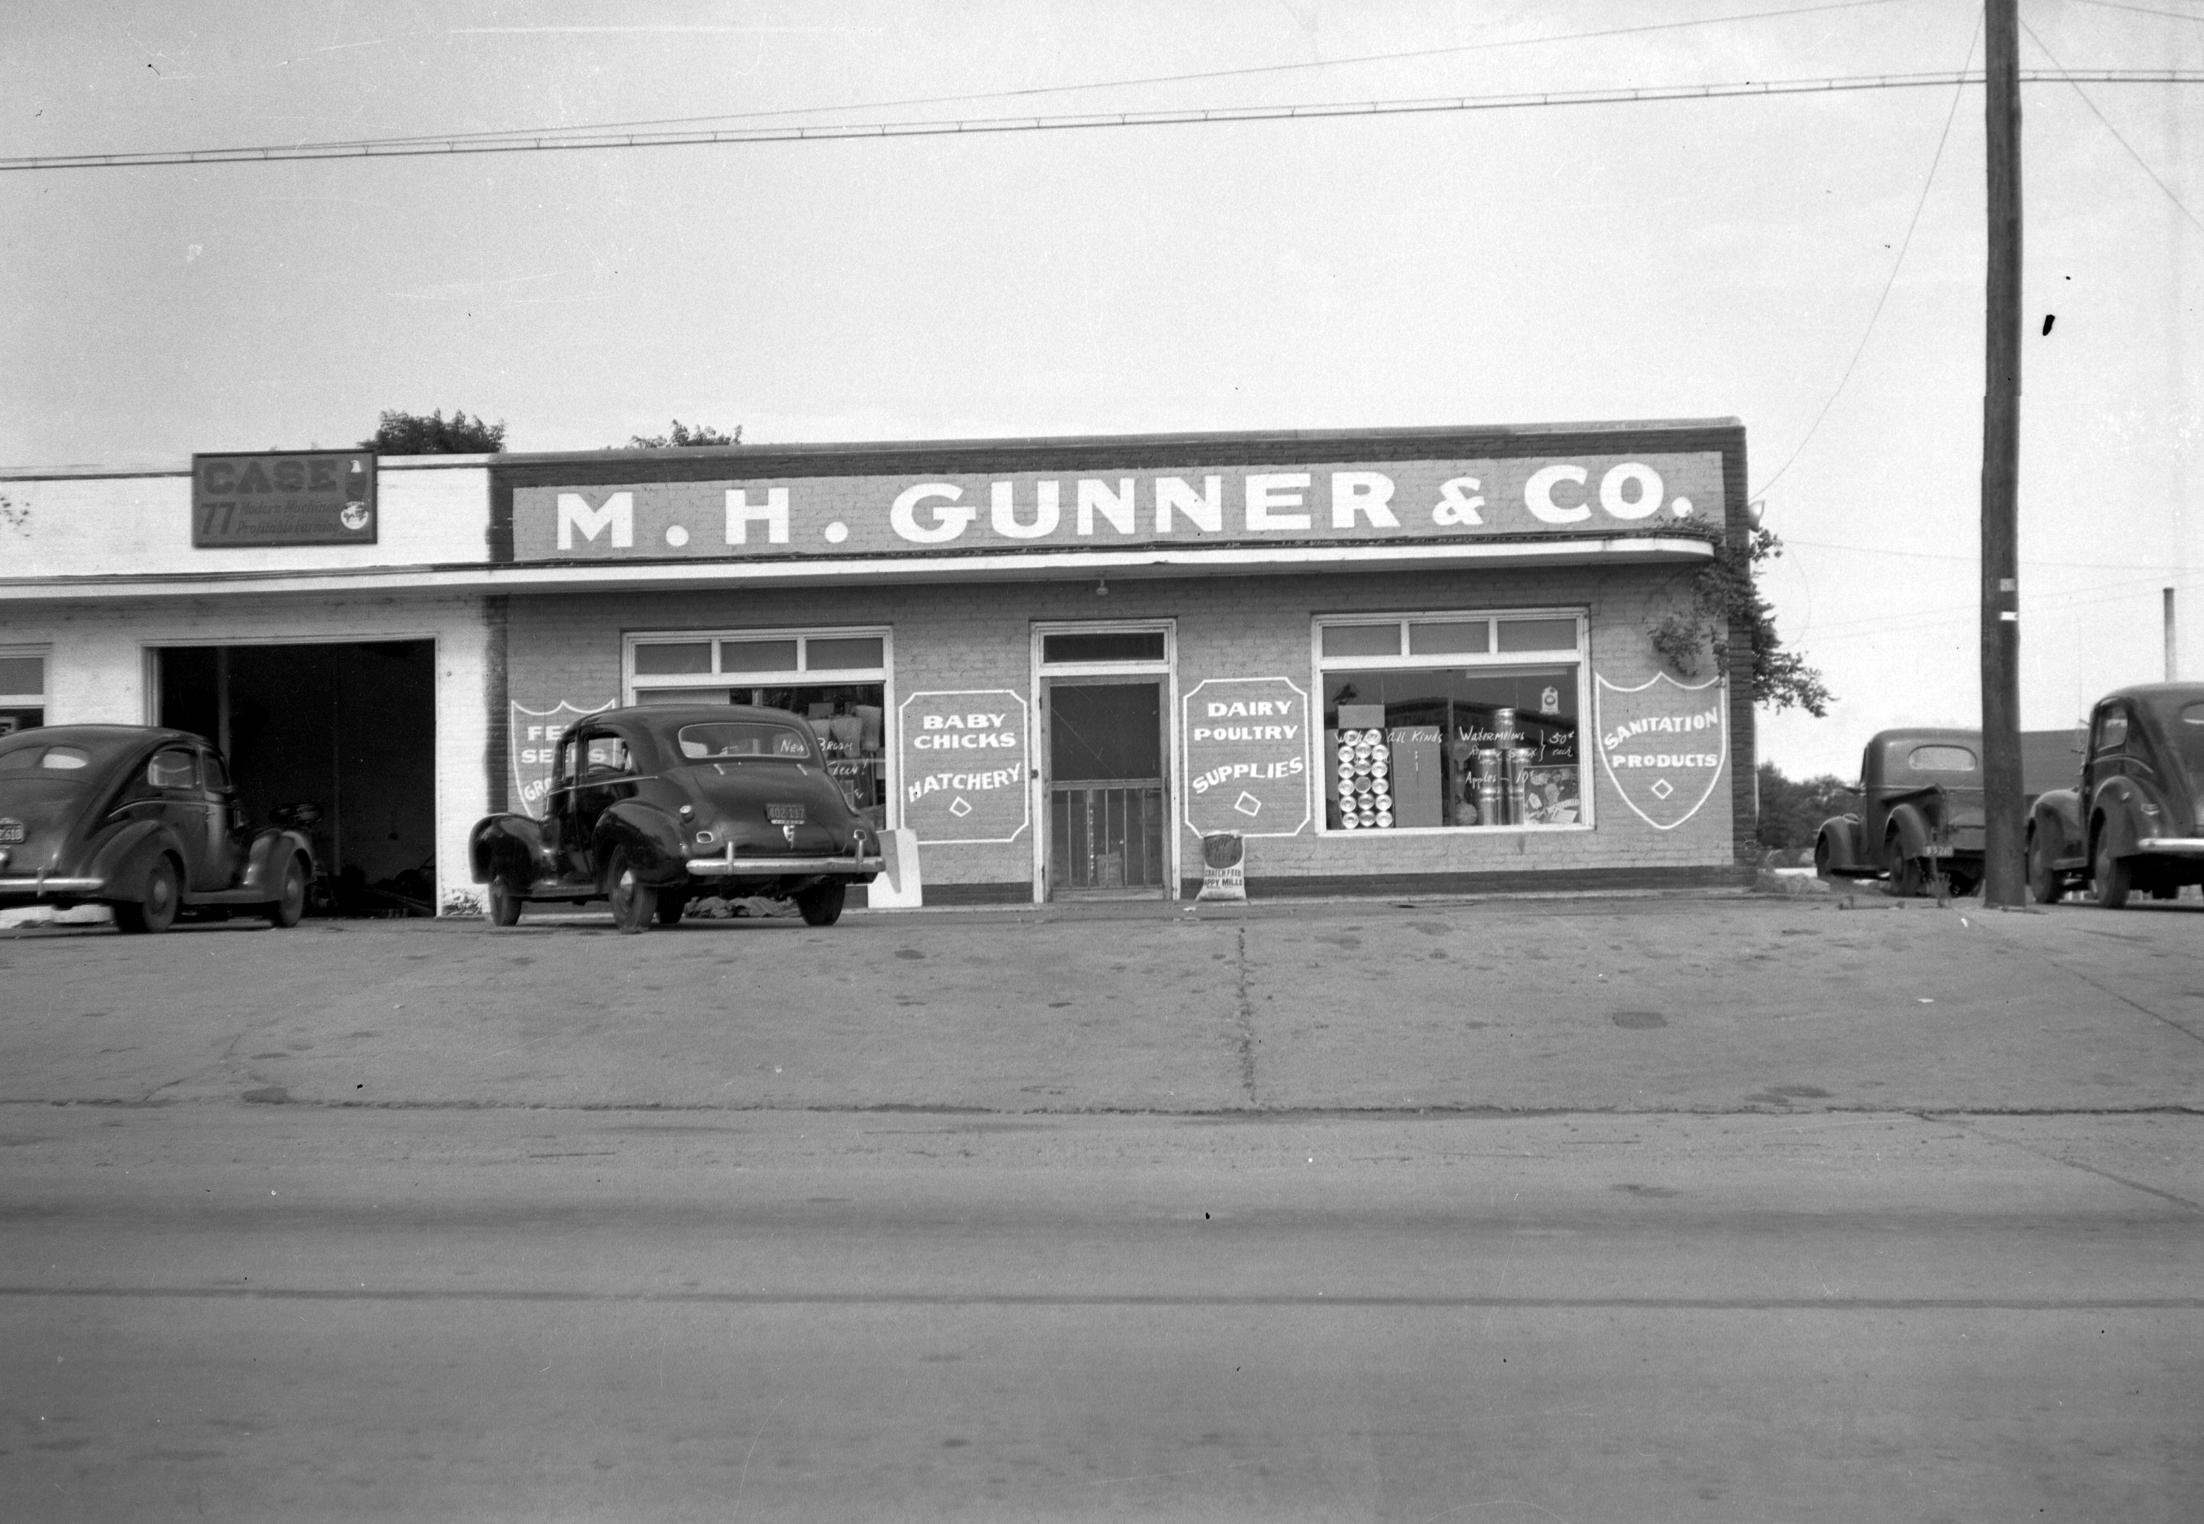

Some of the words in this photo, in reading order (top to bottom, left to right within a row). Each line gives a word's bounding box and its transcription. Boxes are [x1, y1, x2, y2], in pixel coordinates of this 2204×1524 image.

[203, 458, 338, 495] CASE
[201, 501, 236, 535] 77
[557, 491, 690, 549] M.
[725, 487, 848, 545] H.
[890, 472, 1401, 544] GUNNER
[1432, 476, 1486, 527] &
[1524, 462, 1694, 525] CO.
[1207, 700, 1292, 717] DAIRY
[923, 713, 1006, 730] BABY
[1194, 725, 1298, 741] POULTRY
[1603, 706, 1718, 750] SANITATION
[913, 732, 1017, 749] CHICKS
[521, 748, 606, 764] SES
[1612, 753, 1718, 768] PRODUCTS
[908, 762, 1021, 803] HATCHERY
[1192, 756, 1304, 794] SUPPLIES
